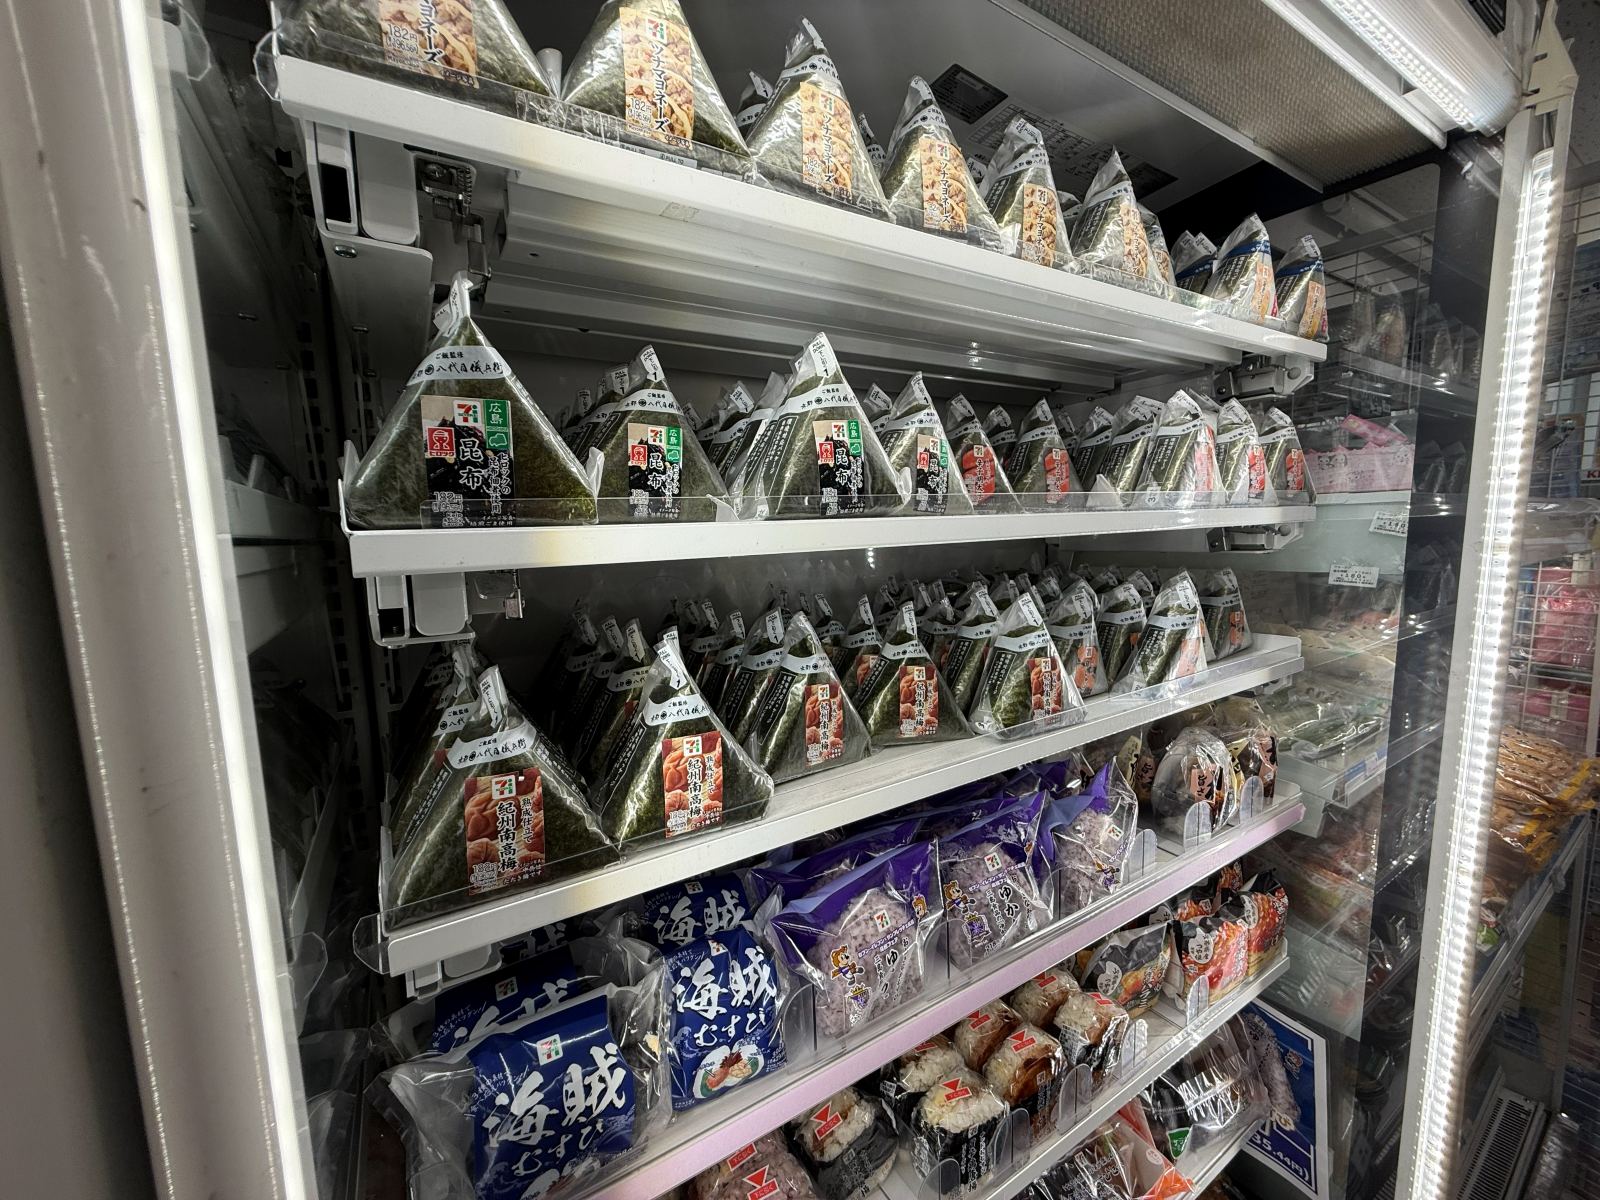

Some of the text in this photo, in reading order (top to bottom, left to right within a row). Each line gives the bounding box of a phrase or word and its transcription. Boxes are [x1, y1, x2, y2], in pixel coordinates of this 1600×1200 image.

[388, 24, 418, 42] 182円
[420, 0, 443, 62] ヨネーズ
[651, 44, 669, 132] ツナマヨネーズ
[822, 114, 835, 183] ツナマヨネーズ
[940, 161, 951, 223] ツナマヨネーズ
[436, 361, 504, 375] 八代目儀兵衛
[652, 372, 657, 380] 1
[824, 369, 829, 377] 1
[488, 403, 503, 424] 広島
[850, 421, 858, 438] 広島
[668, 430, 678, 444] 広島
[460, 438, 483, 490] 昆布
[648, 452, 664, 490] 昆布
[835, 448, 851, 486] 昆布
[676, 680, 681, 688] 1
[916, 682, 925, 727] 紀州南高梅
[476, 738, 527, 758] 八代目儀兵衛
[820, 702, 829, 750] 紀州南高梅
[688, 759, 702, 817] 紀州南高梅
[706, 755, 715, 793] 熟成仕立て
[497, 801, 518, 872] 紀州南高梅
[521, 798, 534, 843] 熟成仕立て
[653, 888, 746, 945] 海賊
[672, 946, 777, 1020] 海賊
[694, 1008, 767, 1047] むすび
[482, 1042, 627, 1147] 海賊
[512, 1118, 604, 1176] むすび
